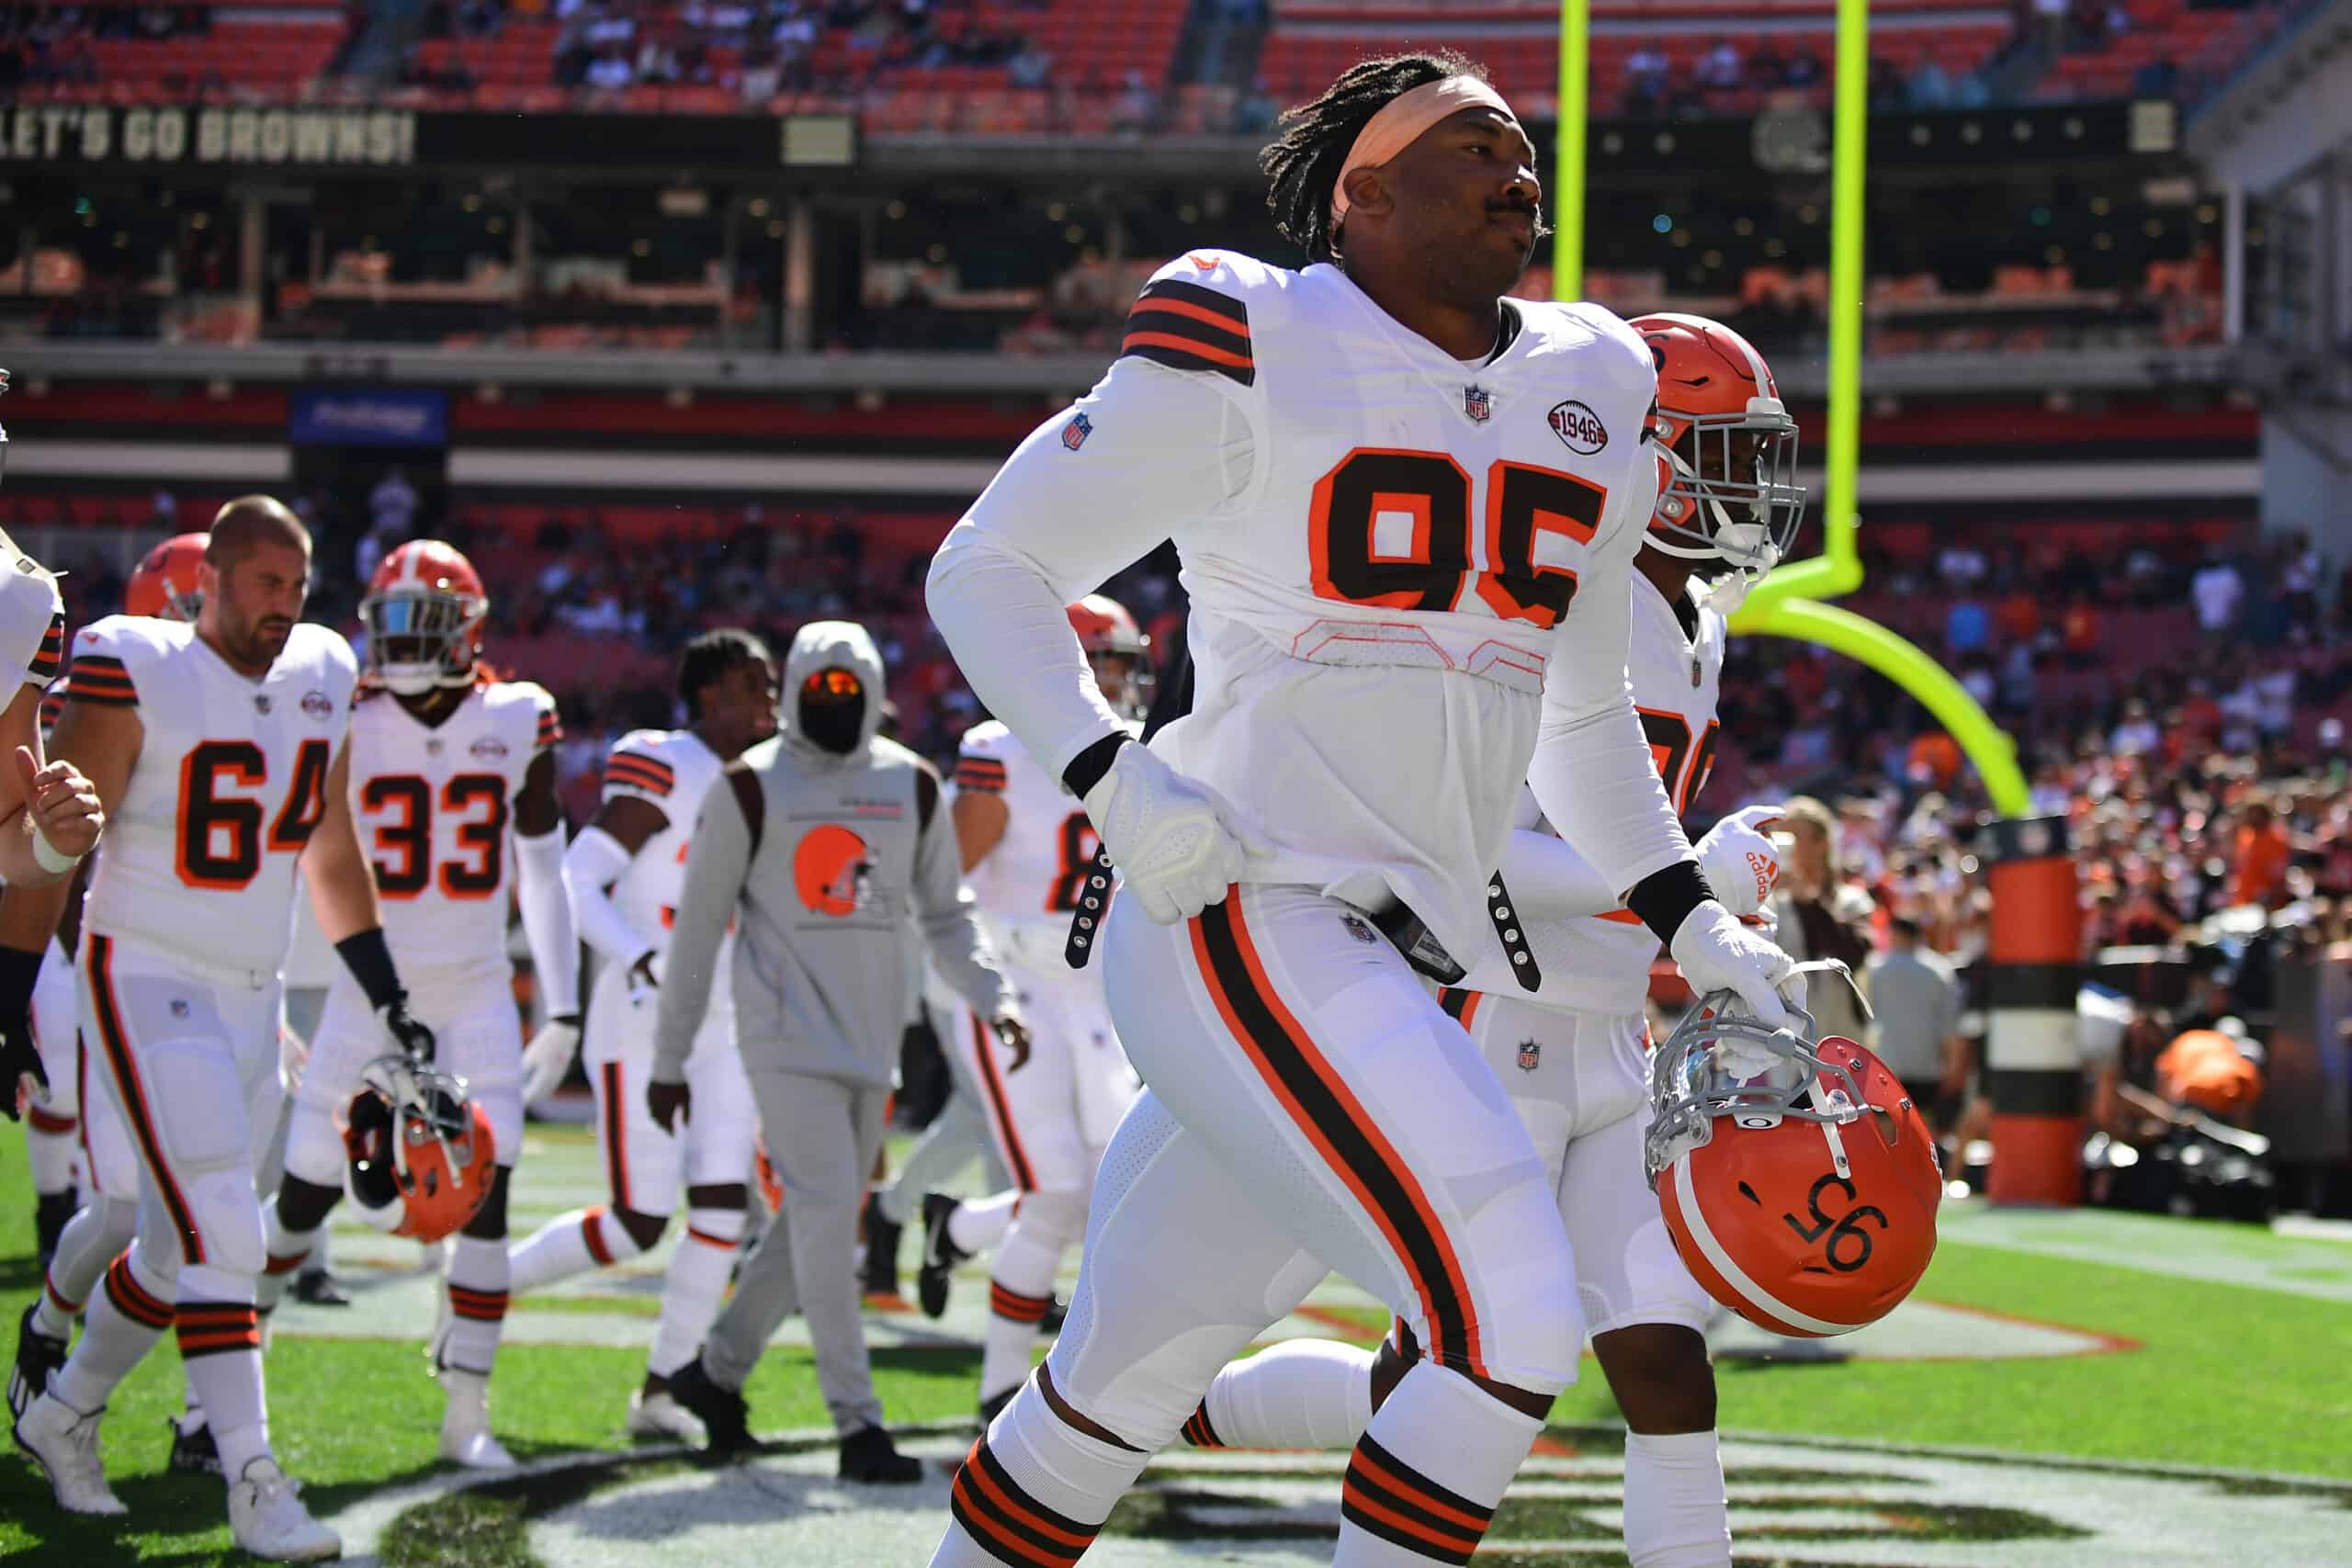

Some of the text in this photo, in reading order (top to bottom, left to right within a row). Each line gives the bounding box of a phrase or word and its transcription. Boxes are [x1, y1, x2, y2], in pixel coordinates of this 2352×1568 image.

[0, 107, 415, 162] ET'S GO BROWNS!
[1560, 410, 1597, 446] 1946
[1307, 446, 1608, 630] 95
[175, 739, 329, 891] 64
[360, 774, 507, 900] 33
[1747, 852, 1767, 903] adidas
[1782, 1173, 1888, 1271] 95
